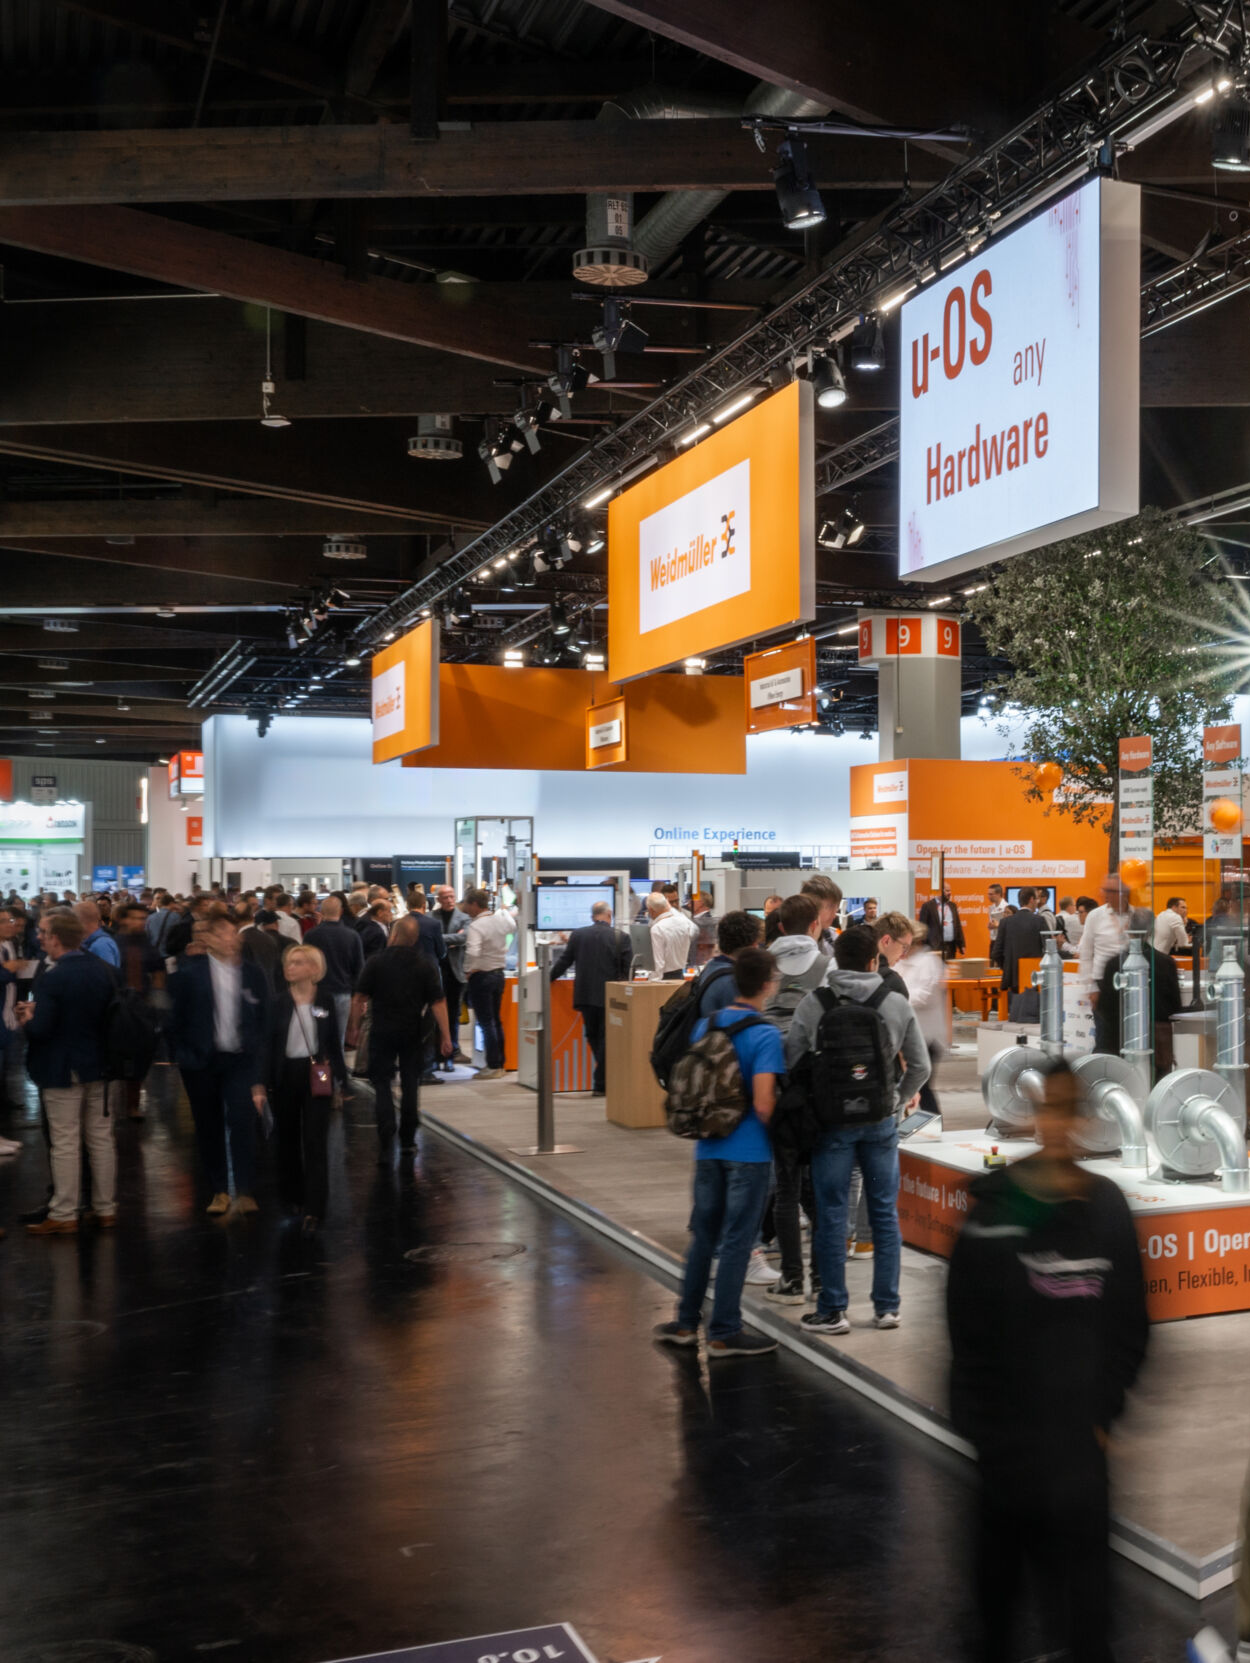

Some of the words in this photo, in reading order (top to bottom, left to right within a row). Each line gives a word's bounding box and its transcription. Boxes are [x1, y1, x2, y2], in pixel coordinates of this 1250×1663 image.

[911, 268, 993, 399] u-OS
[1013, 337, 1047, 387] any
[926, 411, 1049, 505] Hardware
[650, 533, 718, 593] Weidmüller
[862, 627, 869, 650] 9
[898, 625, 911, 648] 9
[943, 626, 953, 649] 9
[654, 827, 699, 840] Online
[703, 827, 776, 842] Experience
[916, 844, 937, 855] Open
[954, 844, 968, 854] the
[970, 844, 996, 854] future
[1005, 844, 1025, 854] u-OS
[981, 864, 995, 875] Any
[999, 864, 1033, 874] Software
[1041, 864, 1056, 875] Any
[1058, 864, 1079, 874] Cloud
[916, 1176, 940, 1203] future
[947, 1188, 968, 1213] u-OS
[1141, 1232, 1178, 1260] -OS
[1178, 1265, 1239, 1291] Flexible,
